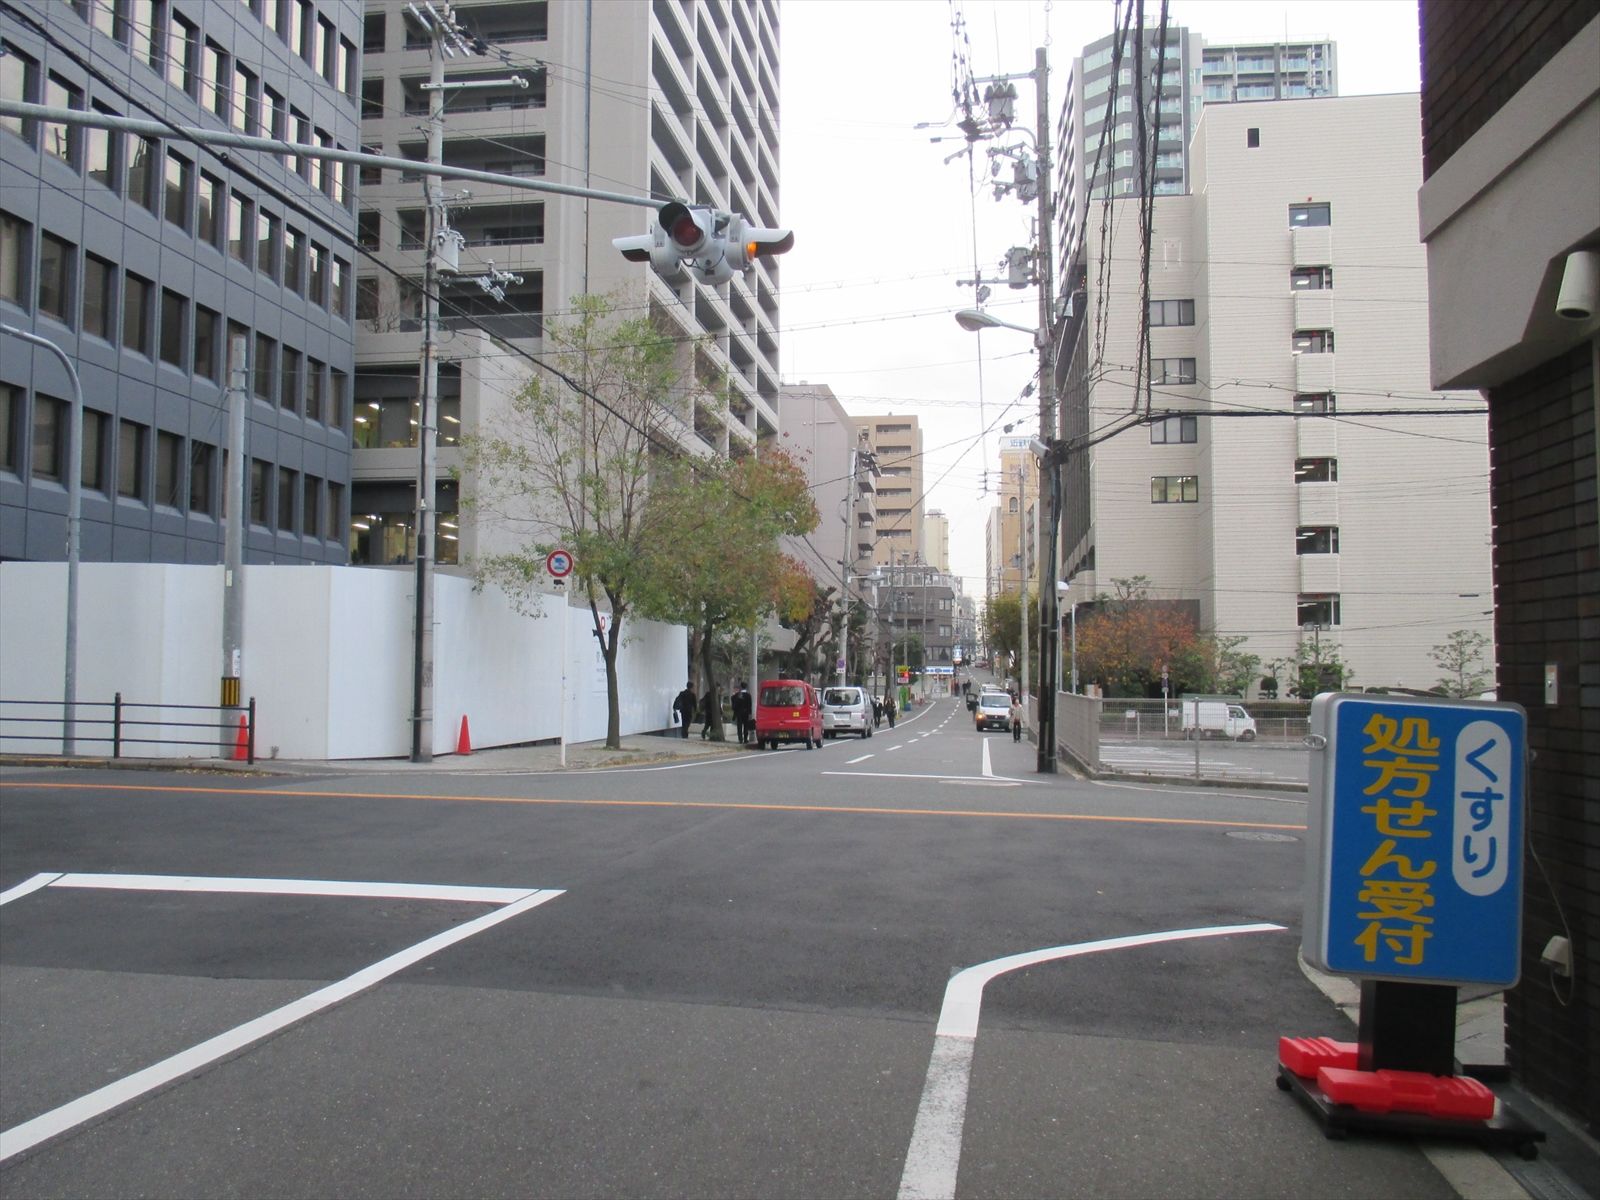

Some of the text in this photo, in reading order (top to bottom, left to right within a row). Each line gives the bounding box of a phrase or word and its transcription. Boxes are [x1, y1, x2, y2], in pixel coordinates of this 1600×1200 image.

[1354, 713, 1440, 965] 処方せん受付
[1460, 738, 1504, 878] くすり
